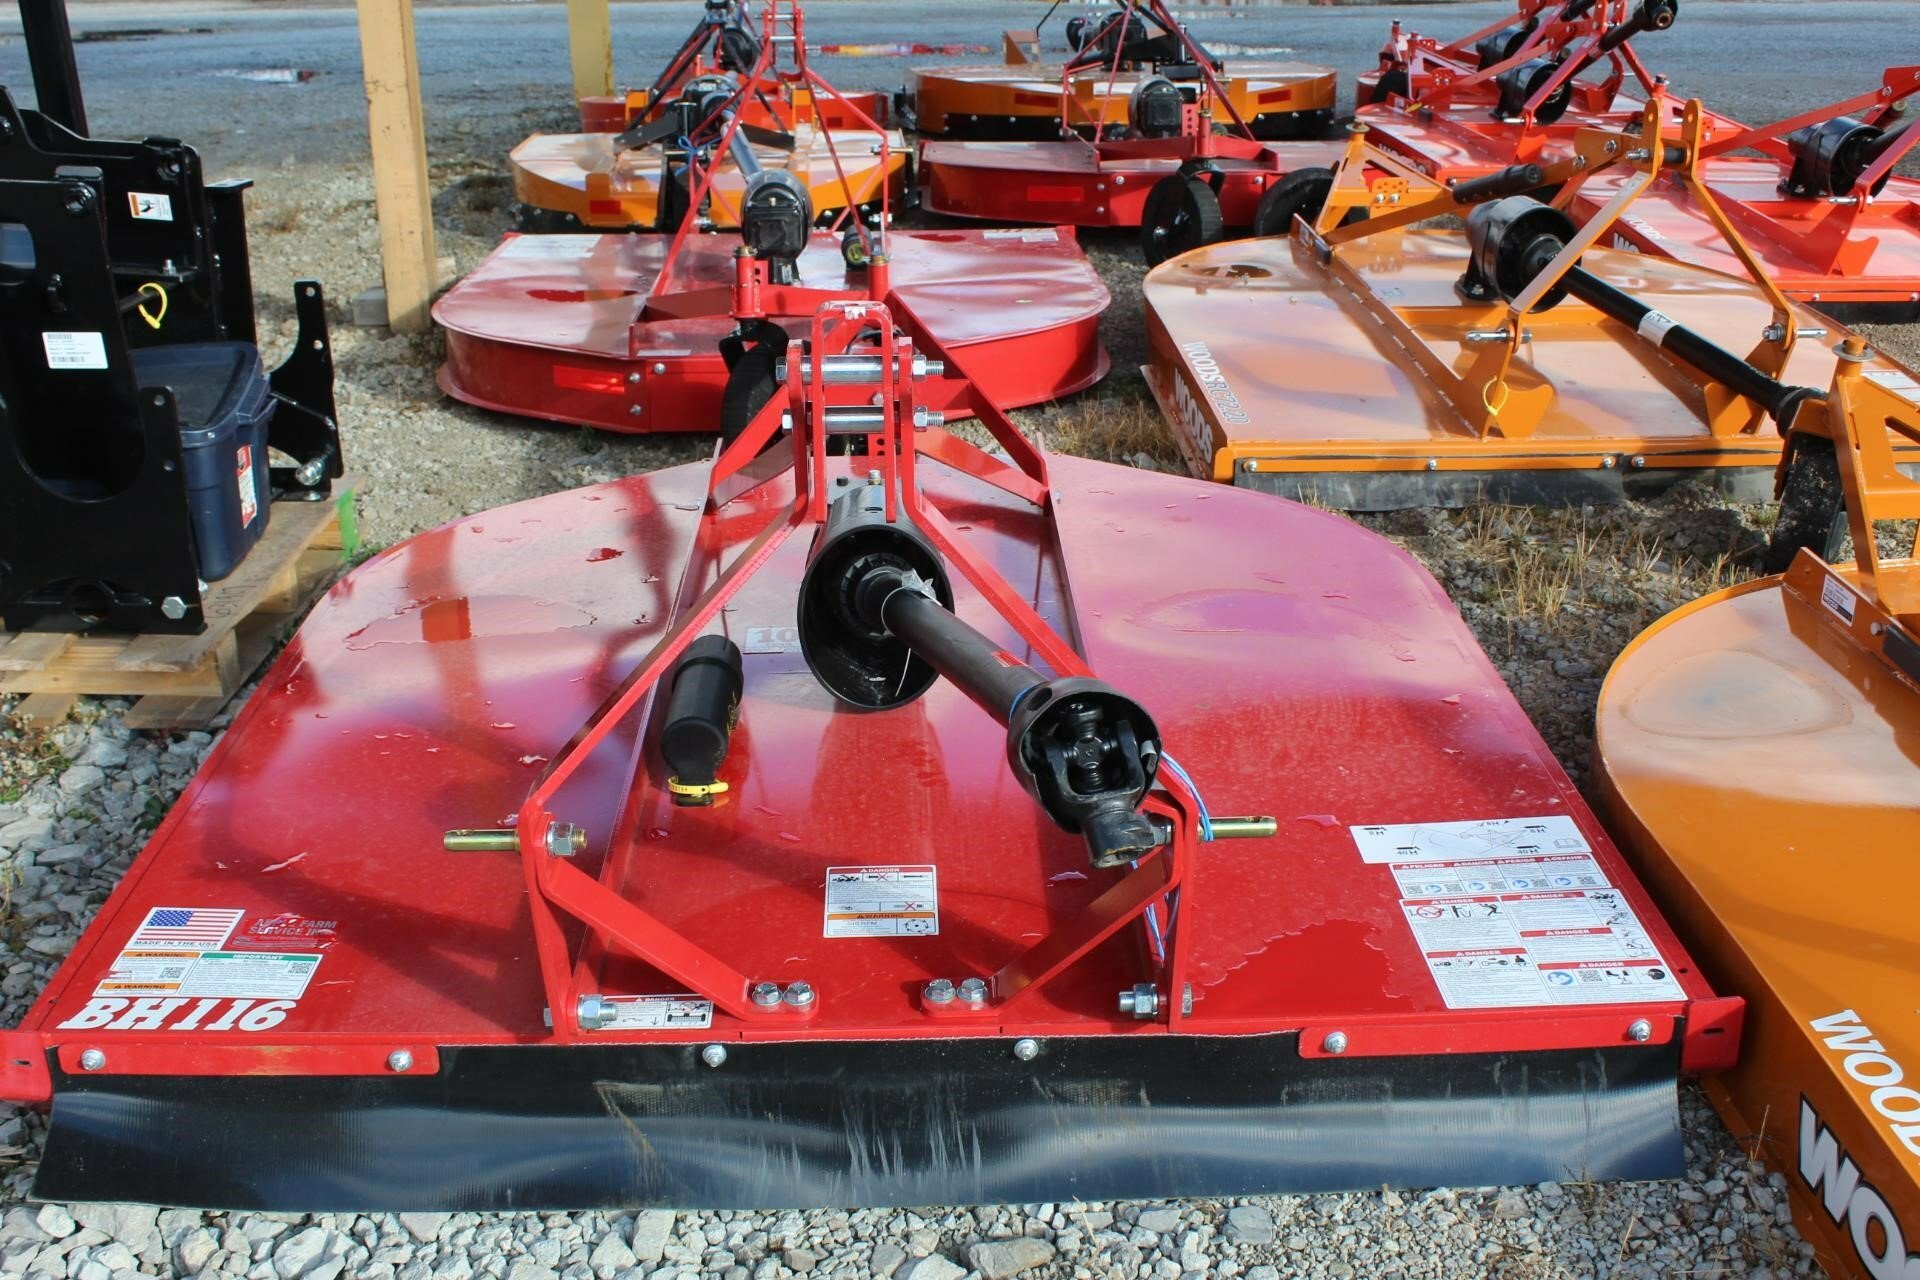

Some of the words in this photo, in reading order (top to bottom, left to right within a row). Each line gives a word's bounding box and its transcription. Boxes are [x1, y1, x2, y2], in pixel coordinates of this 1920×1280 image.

[1182, 341, 1224, 383] WOODS
[1175, 367, 1213, 464] WOODS
[248, 926, 304, 936] SERVICE
[300, 920, 338, 929] FARM
[56, 997, 297, 1032] BH116
[1798, 1089, 1920, 1280] WO
